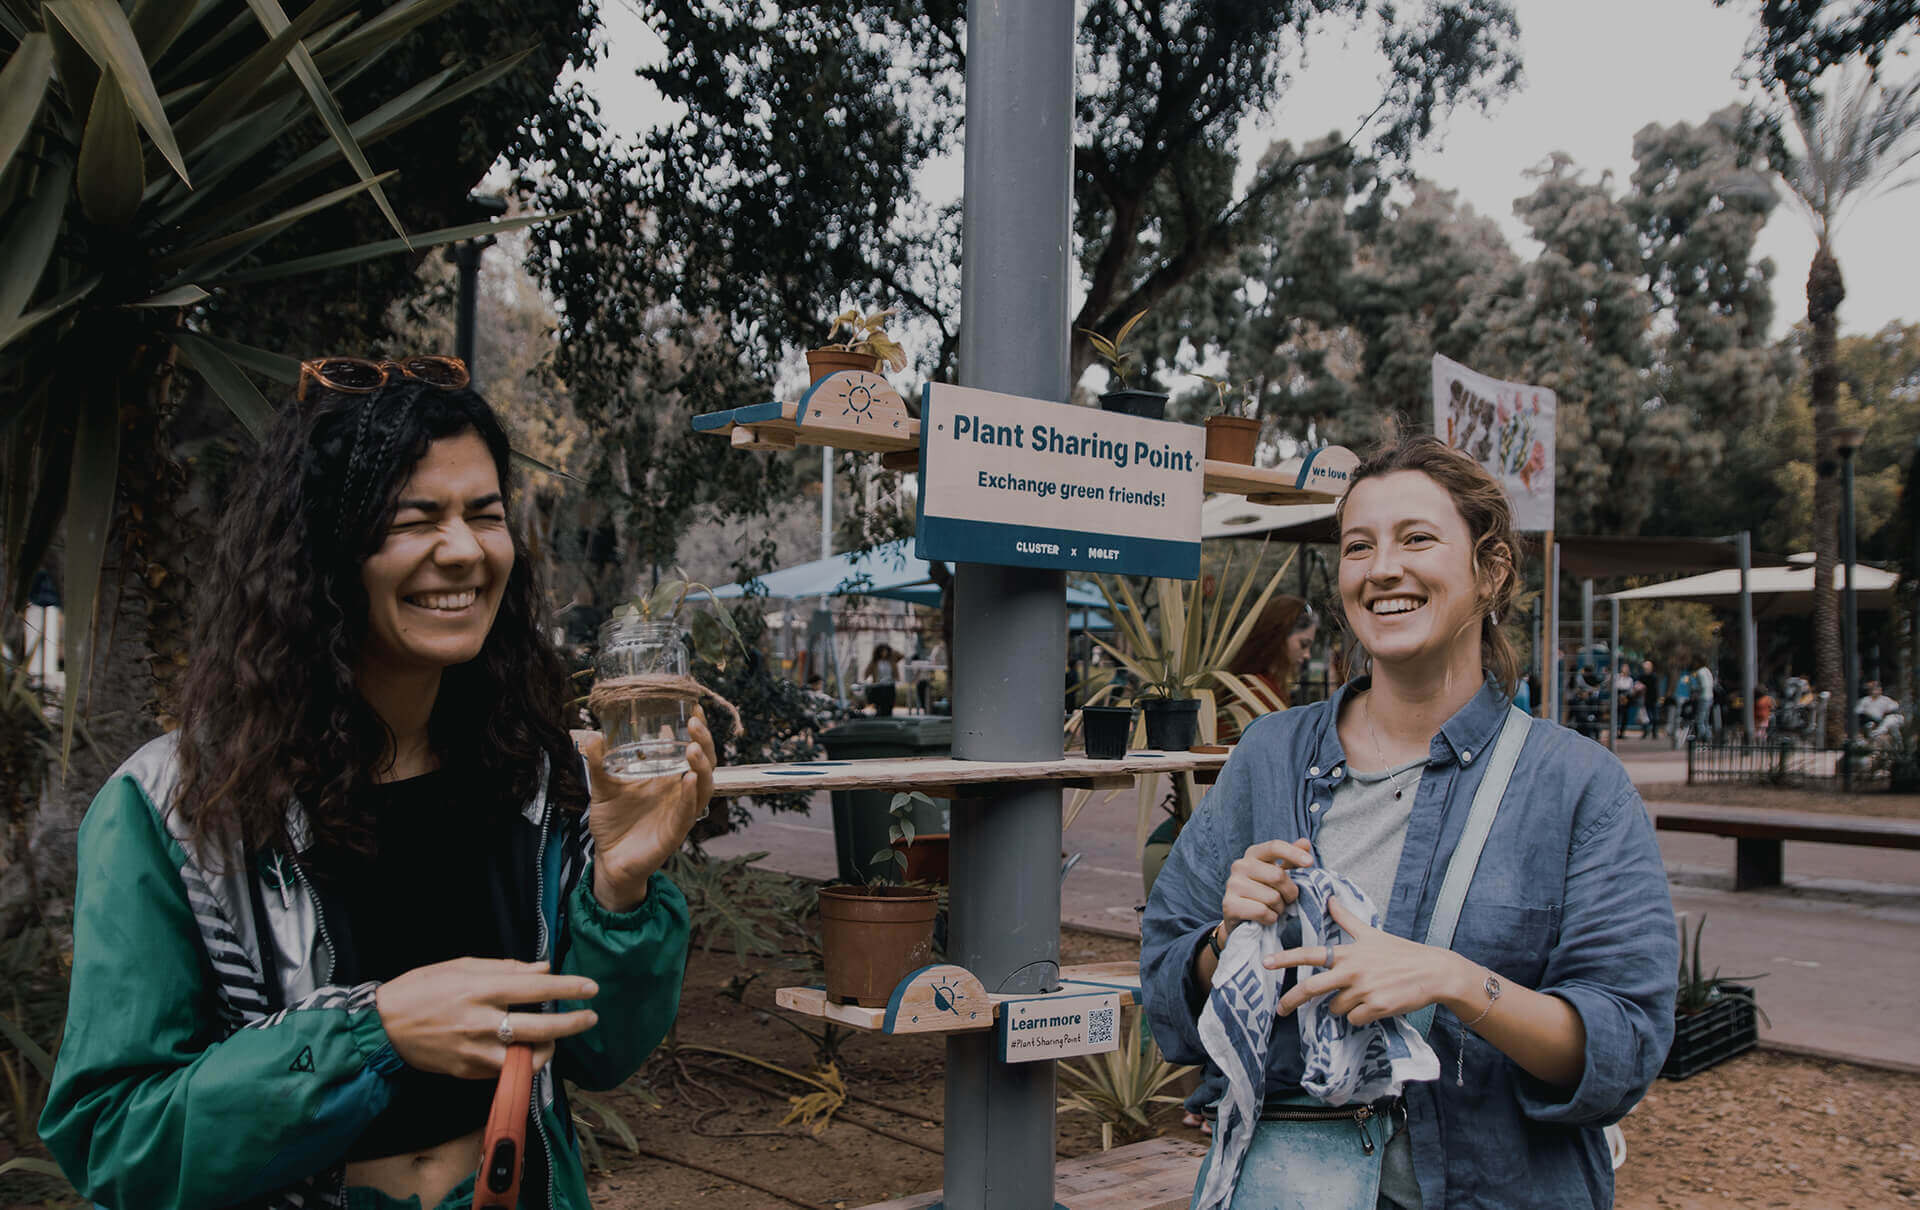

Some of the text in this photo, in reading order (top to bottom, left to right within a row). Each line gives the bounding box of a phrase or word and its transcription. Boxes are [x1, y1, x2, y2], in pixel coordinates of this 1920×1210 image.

[953, 414, 1193, 472] Plant Sharing Point
[1328, 466, 1347, 480] love
[978, 471, 1166, 507] Exchange green friends!
[1016, 541, 1060, 556] CLUSTER
[1088, 546, 1120, 561] MOLET
[1011, 1014, 1081, 1031] Learn more
